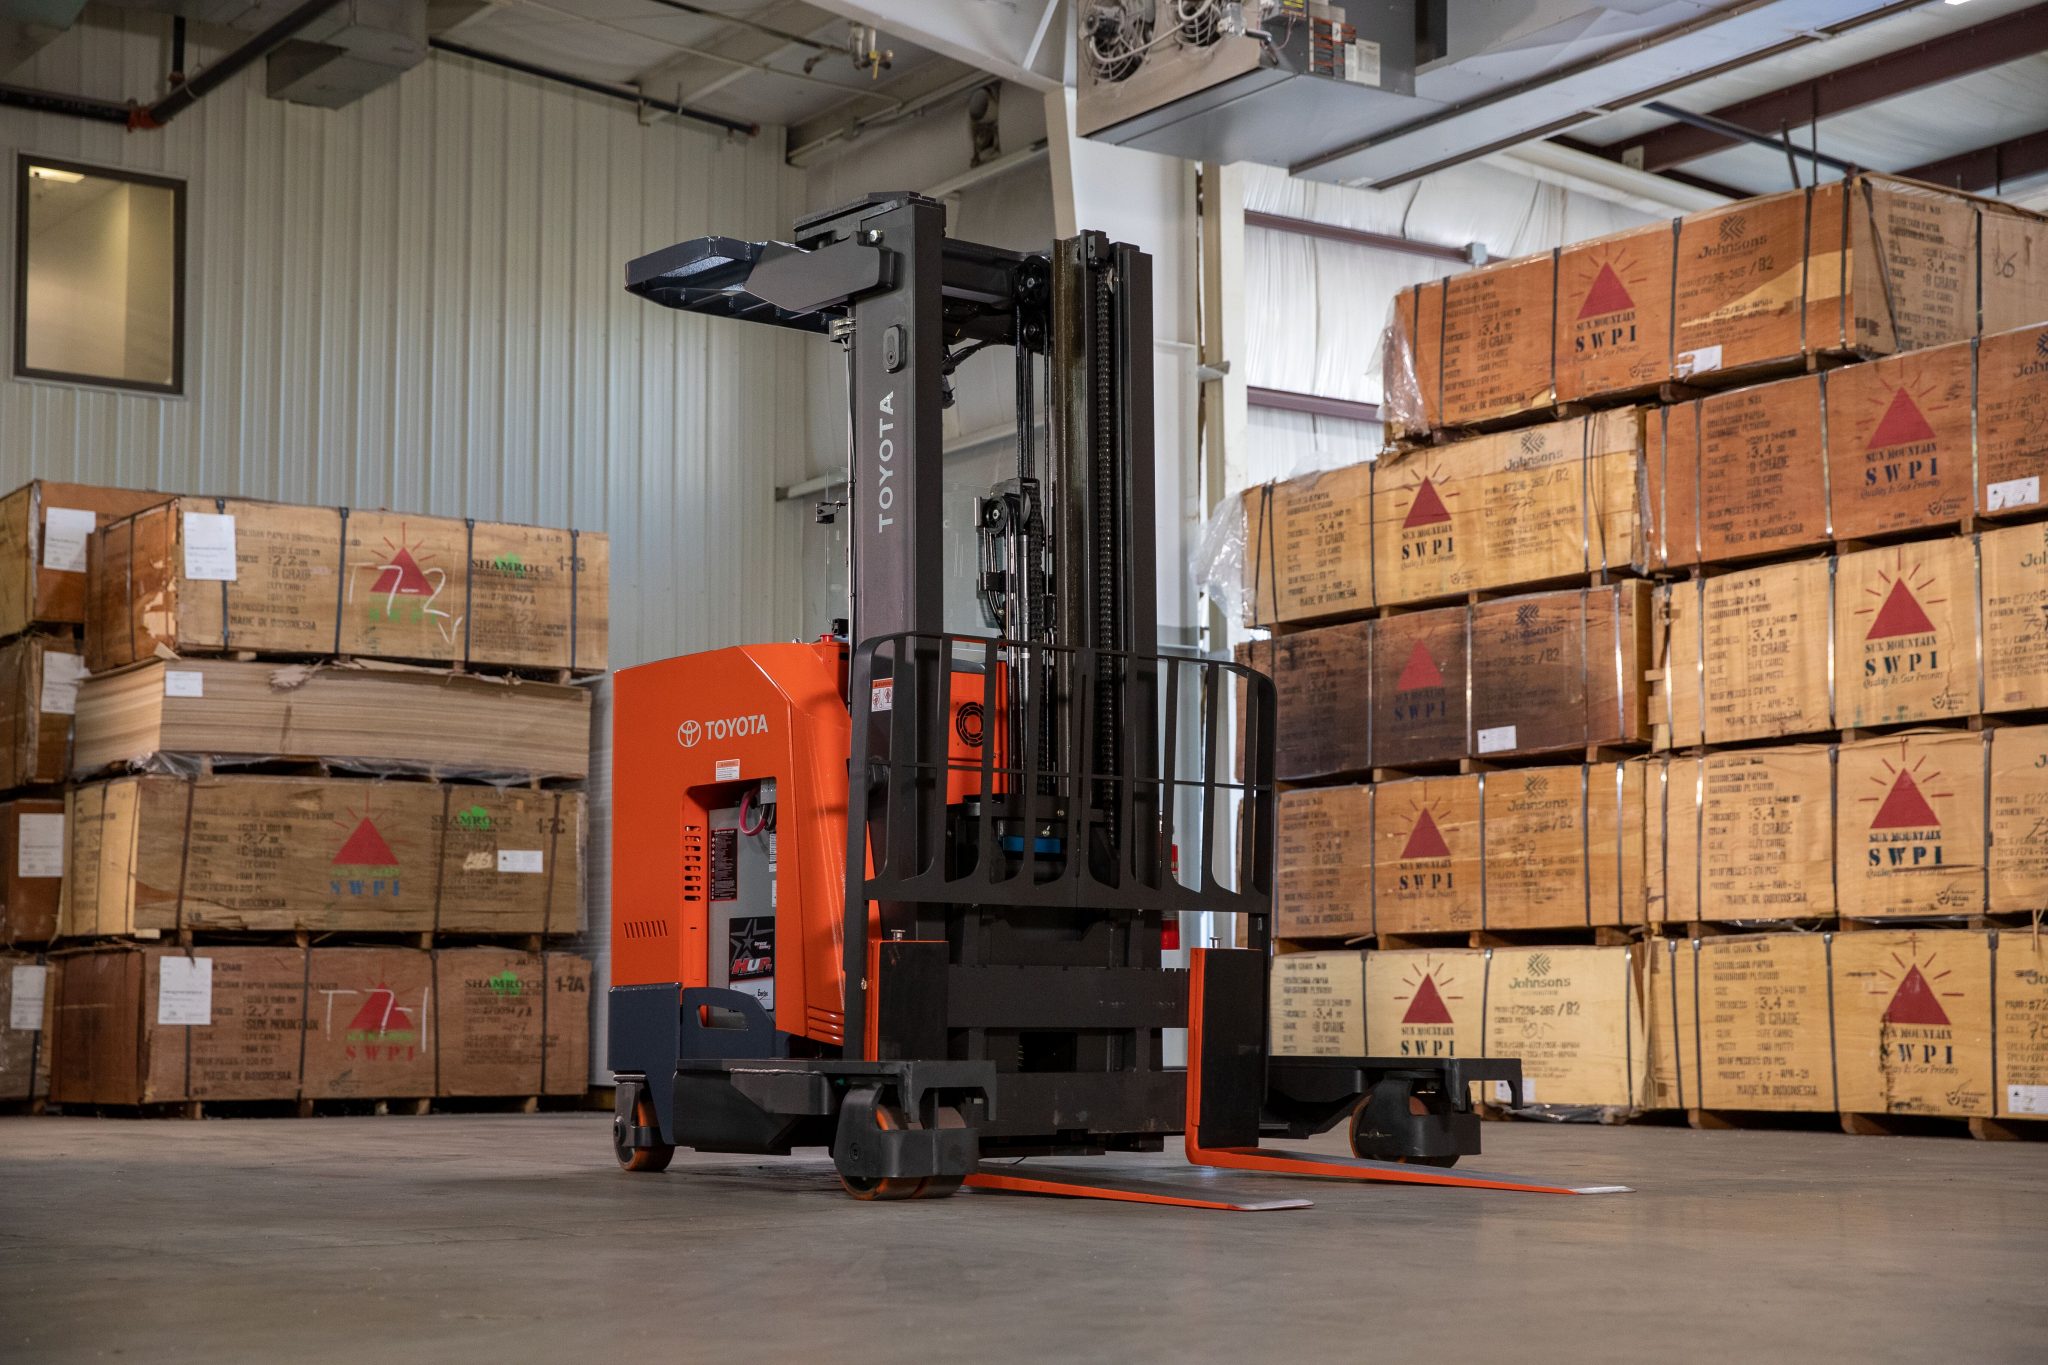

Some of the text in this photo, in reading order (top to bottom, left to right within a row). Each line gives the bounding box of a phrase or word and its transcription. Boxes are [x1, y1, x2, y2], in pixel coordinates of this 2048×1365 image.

[1697, 235, 1768, 260] Johnsons
[1575, 324, 1638, 354] SWPI
[878, 391, 895, 535] TOYOTA
[1504, 450, 1564, 472] Johnsons
[1866, 443, 1938, 464] SUN MOUNTAIN
[1864, 457, 1939, 487] SWPI
[1401, 536, 1454, 561] SWPI
[471, 559, 555, 573] SHAMROCK
[1865, 635, 1937, 654] SUN MOUNTAIN
[1865, 651, 1938, 678] SWPI
[1394, 700, 1446, 722] SWPI
[704, 714, 769, 741] TOYOTA
[1507, 798, 1568, 813] Johnsons
[431, 815, 513, 828] SHAMROCK
[1890, 829, 1942, 843] MOUNTAIN
[1868, 845, 1943, 867] SWPI
[330, 880, 400, 897] SWPI
[1398, 872, 1454, 891] SWPI
[464, 978, 545, 989] SHAMROCK
[554, 976, 585, 993] 1-7A
[1508, 977, 1571, 990] Johnsons
[1901, 1028, 1953, 1041] MOUNTAIN
[346, 1045, 416, 1063] SWPI
[1401, 1039, 1456, 1057] SWPI
